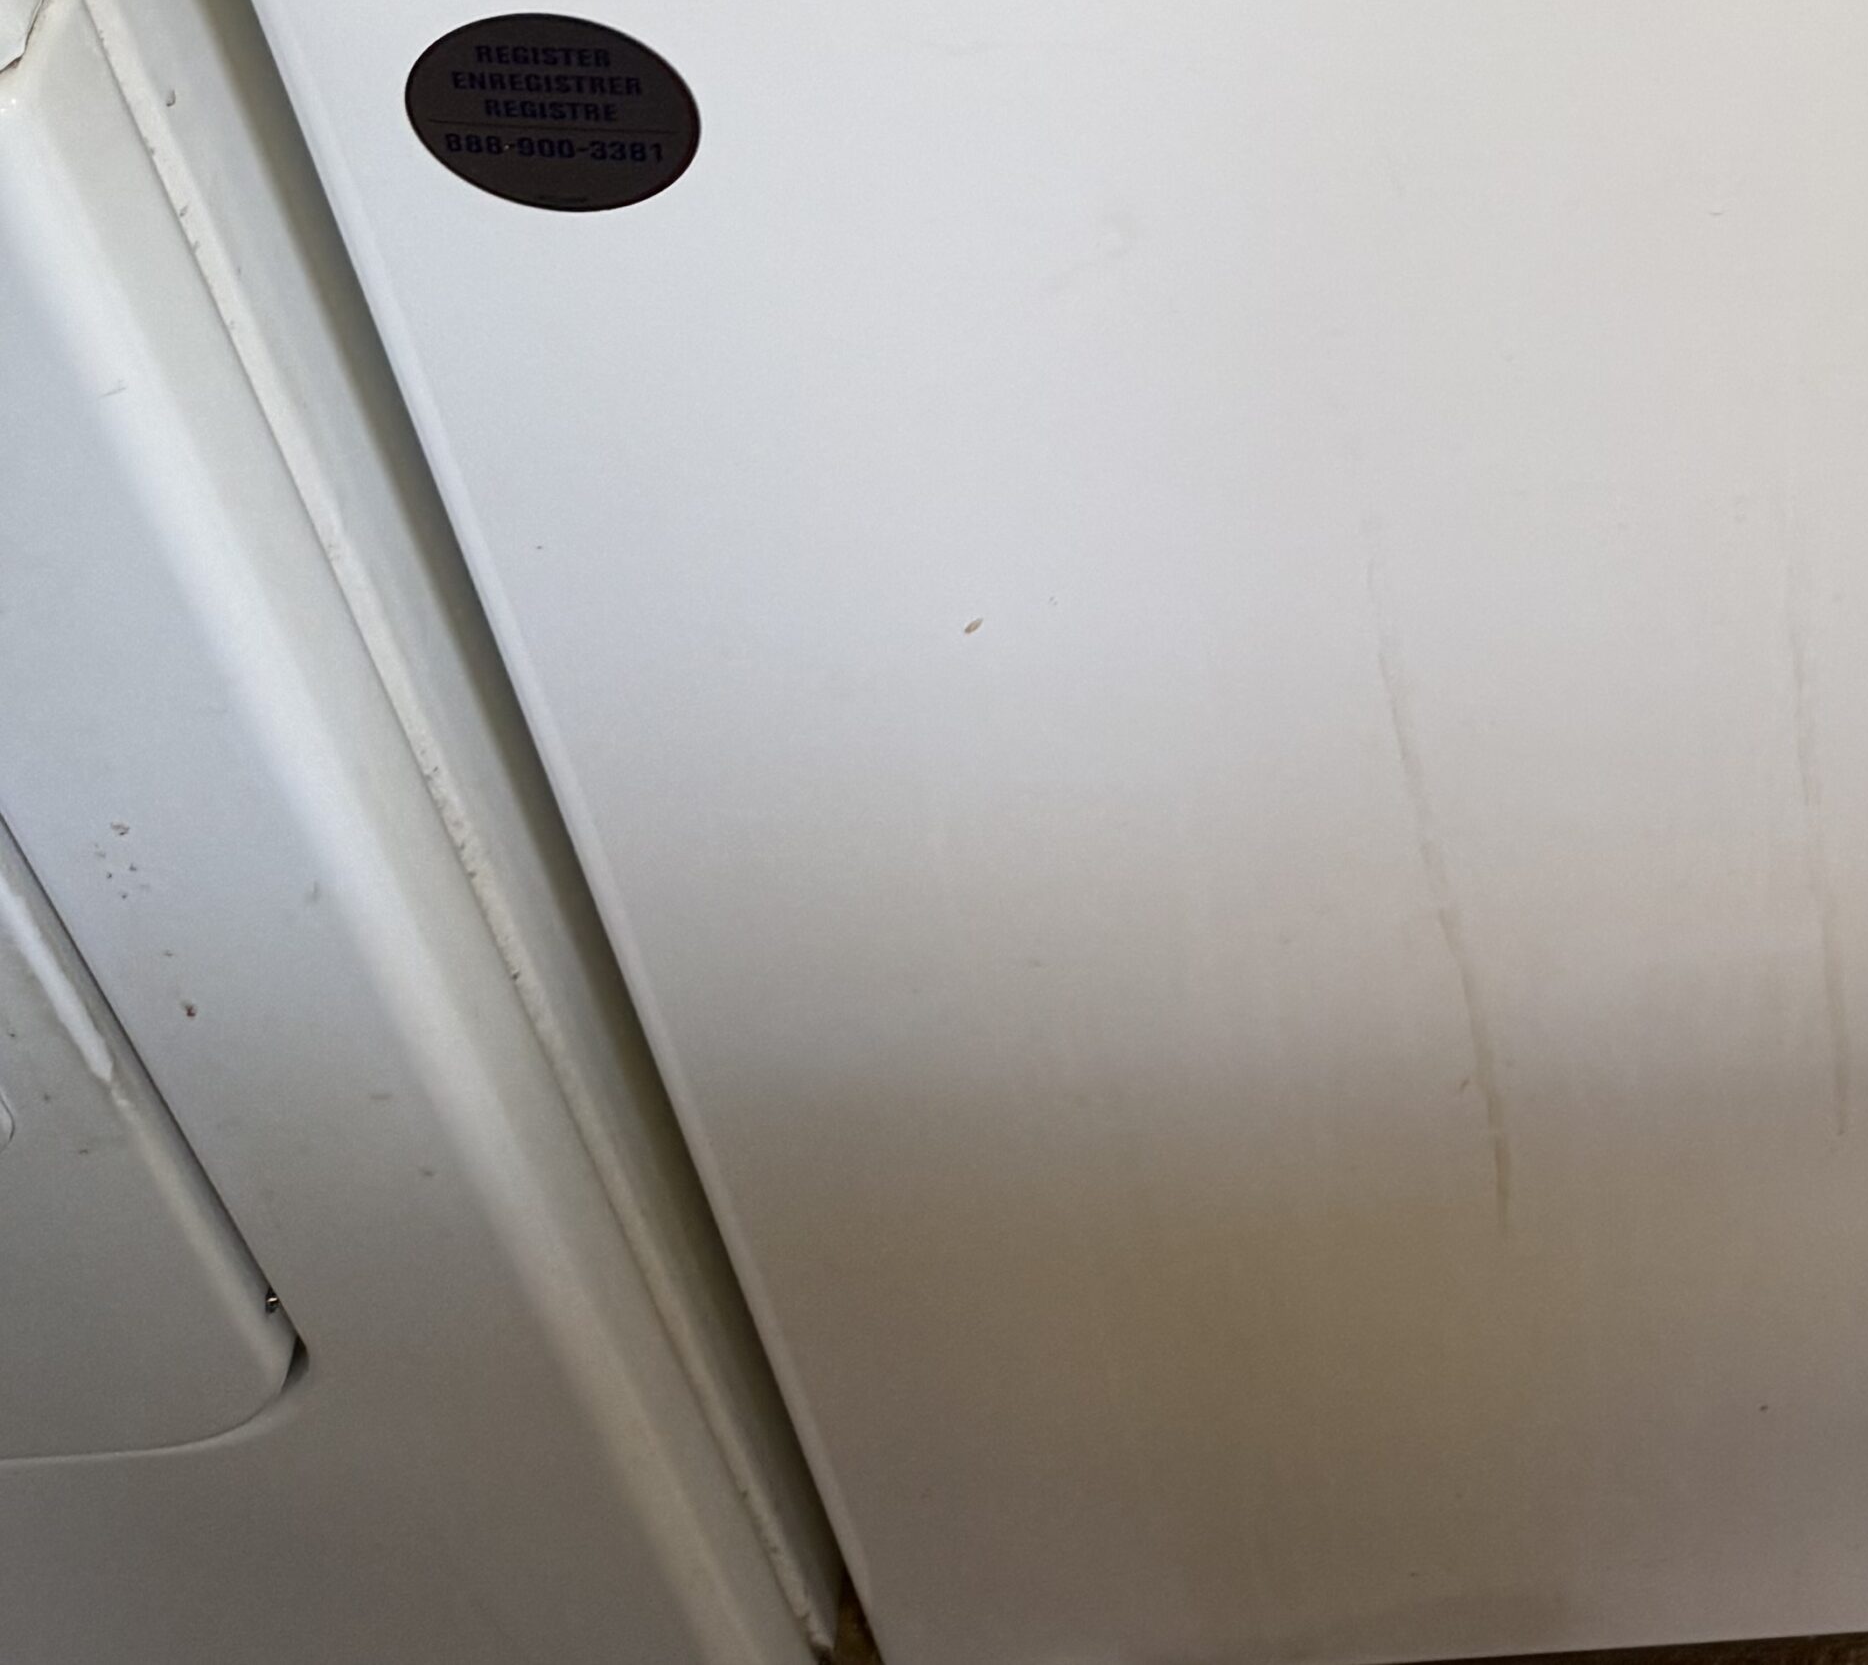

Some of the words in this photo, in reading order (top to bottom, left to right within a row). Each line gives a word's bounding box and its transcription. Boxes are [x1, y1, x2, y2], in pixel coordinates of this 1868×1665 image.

[475, 44, 611, 69] REGISTER
[452, 70, 643, 97] ENREGISTRER
[484, 98, 619, 123] REGISTRE
[445, 132, 664, 164] 888-900-3381
